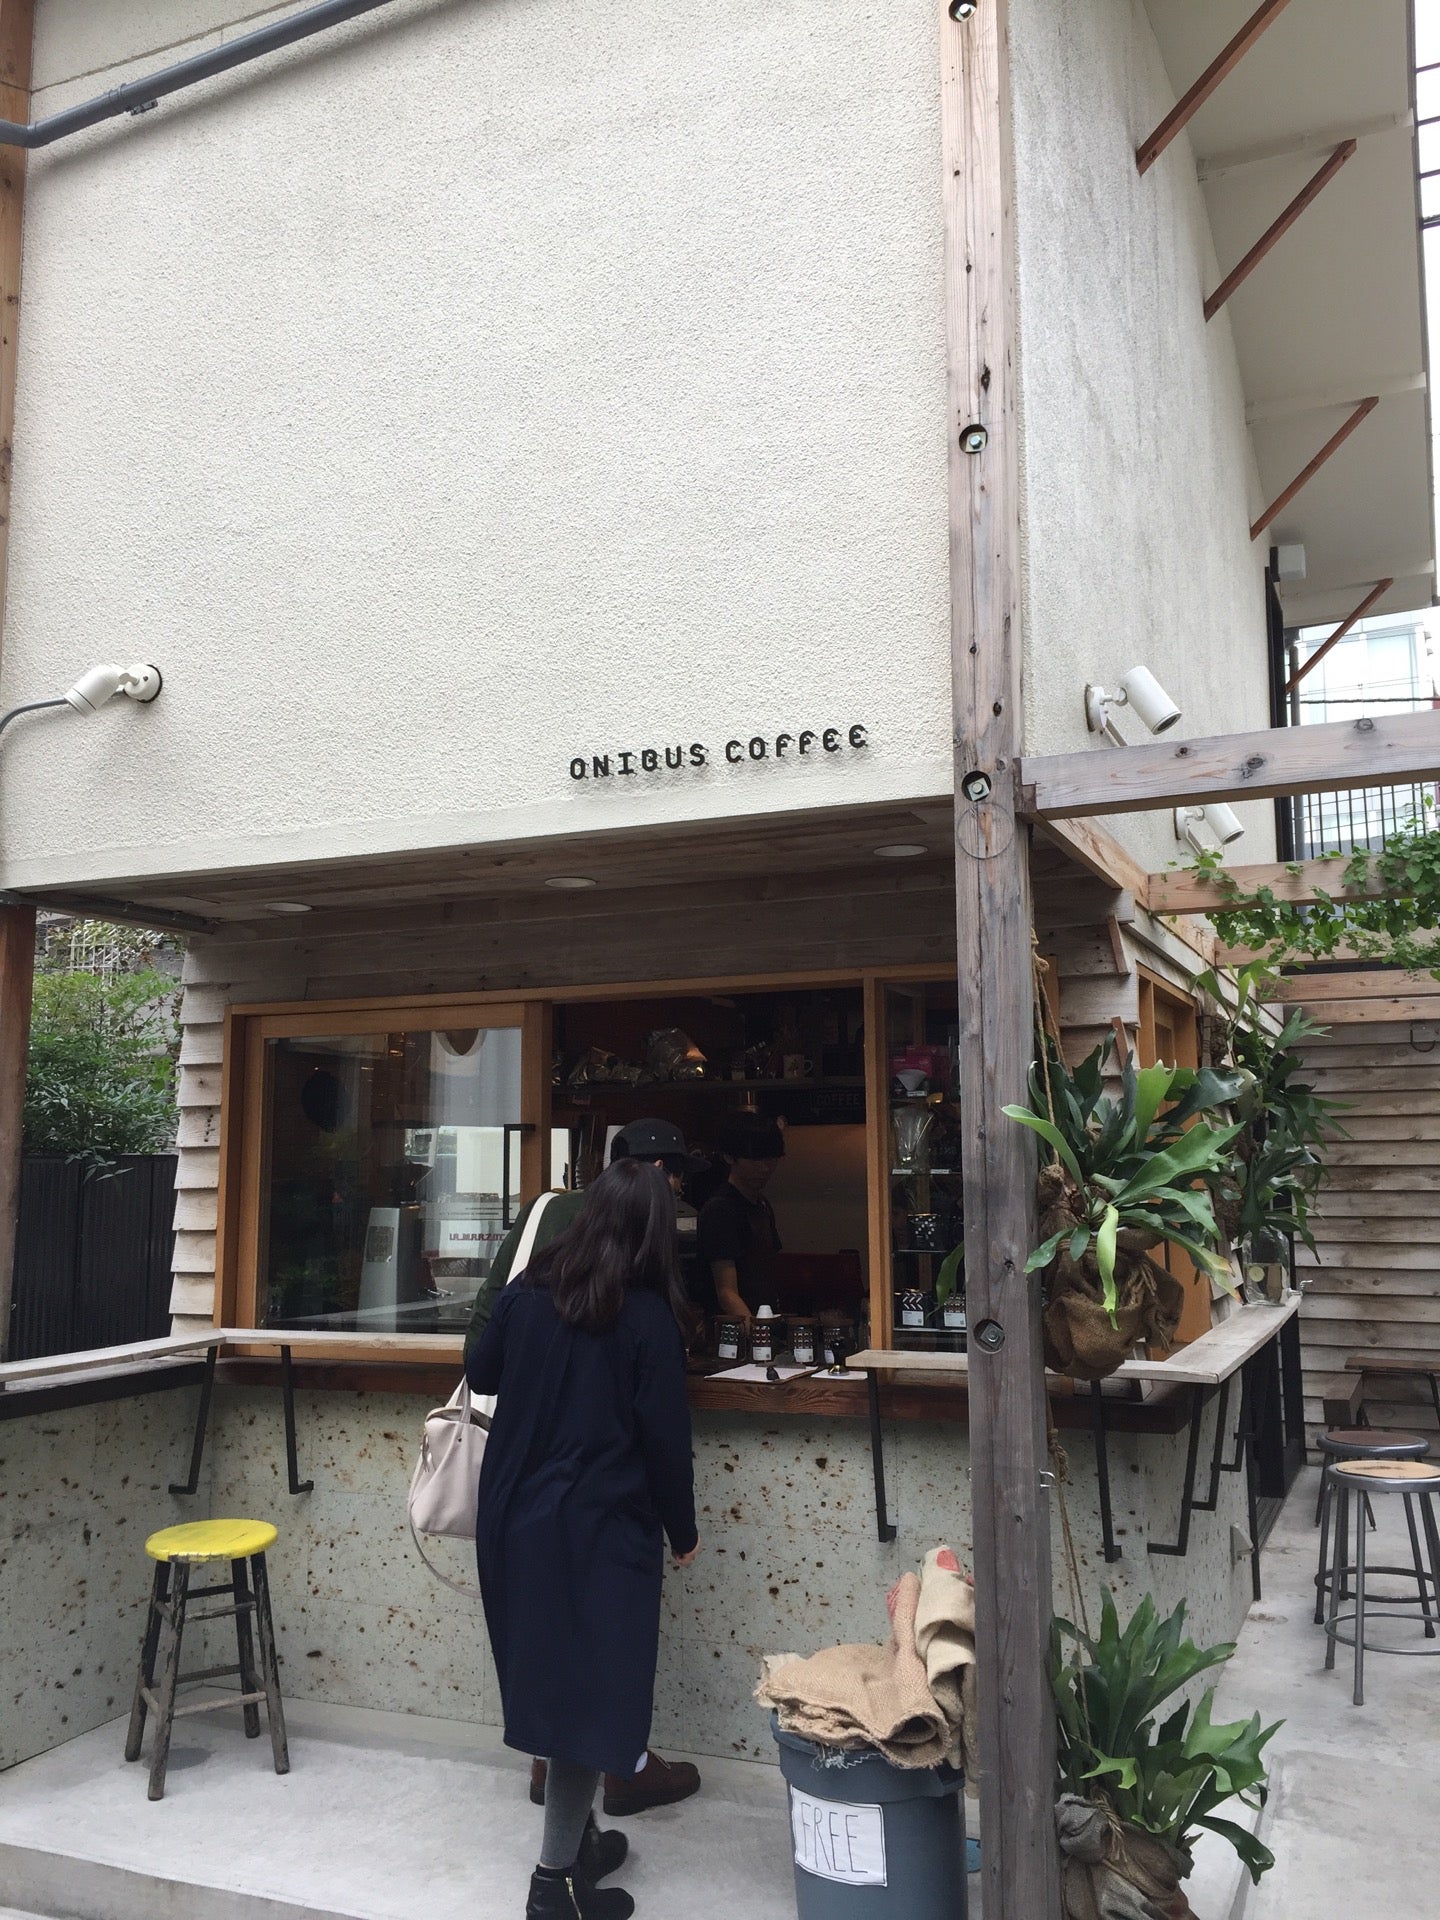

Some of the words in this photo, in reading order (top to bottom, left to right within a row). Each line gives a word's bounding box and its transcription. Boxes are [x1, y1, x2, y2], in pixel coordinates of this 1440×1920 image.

[570, 743, 706, 780] ONIBUS
[725, 724, 867, 763] COFFEE
[800, 1802, 868, 1873] FREE
